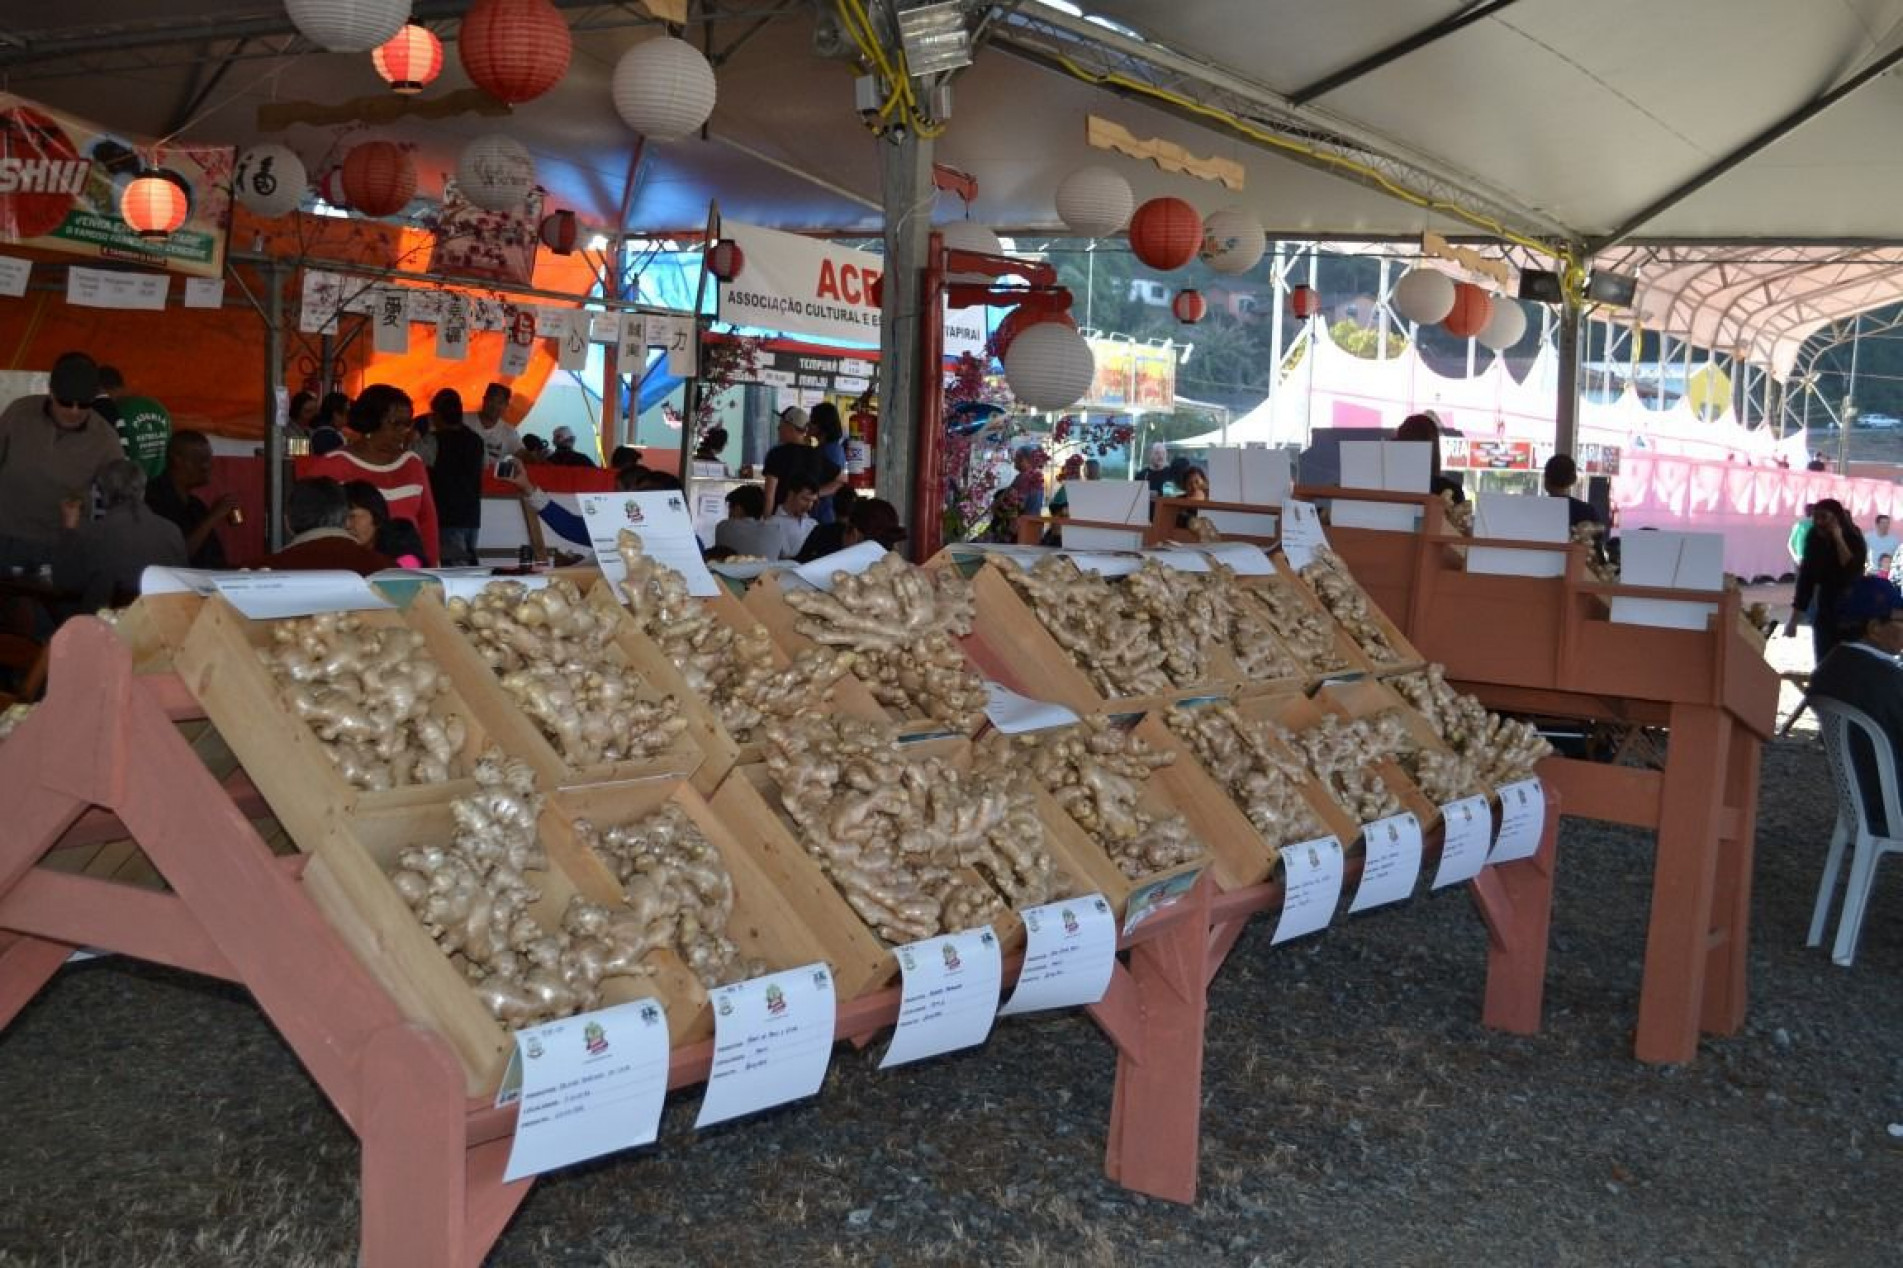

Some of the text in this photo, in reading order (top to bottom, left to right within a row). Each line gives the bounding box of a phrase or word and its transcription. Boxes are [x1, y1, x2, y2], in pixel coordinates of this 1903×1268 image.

[728, 291, 802, 316] ASSOCIAÇÃO
[805, 304, 860, 323] CULTURAL
[863, 313, 870, 325] E
[671, 328, 688, 351] 力
